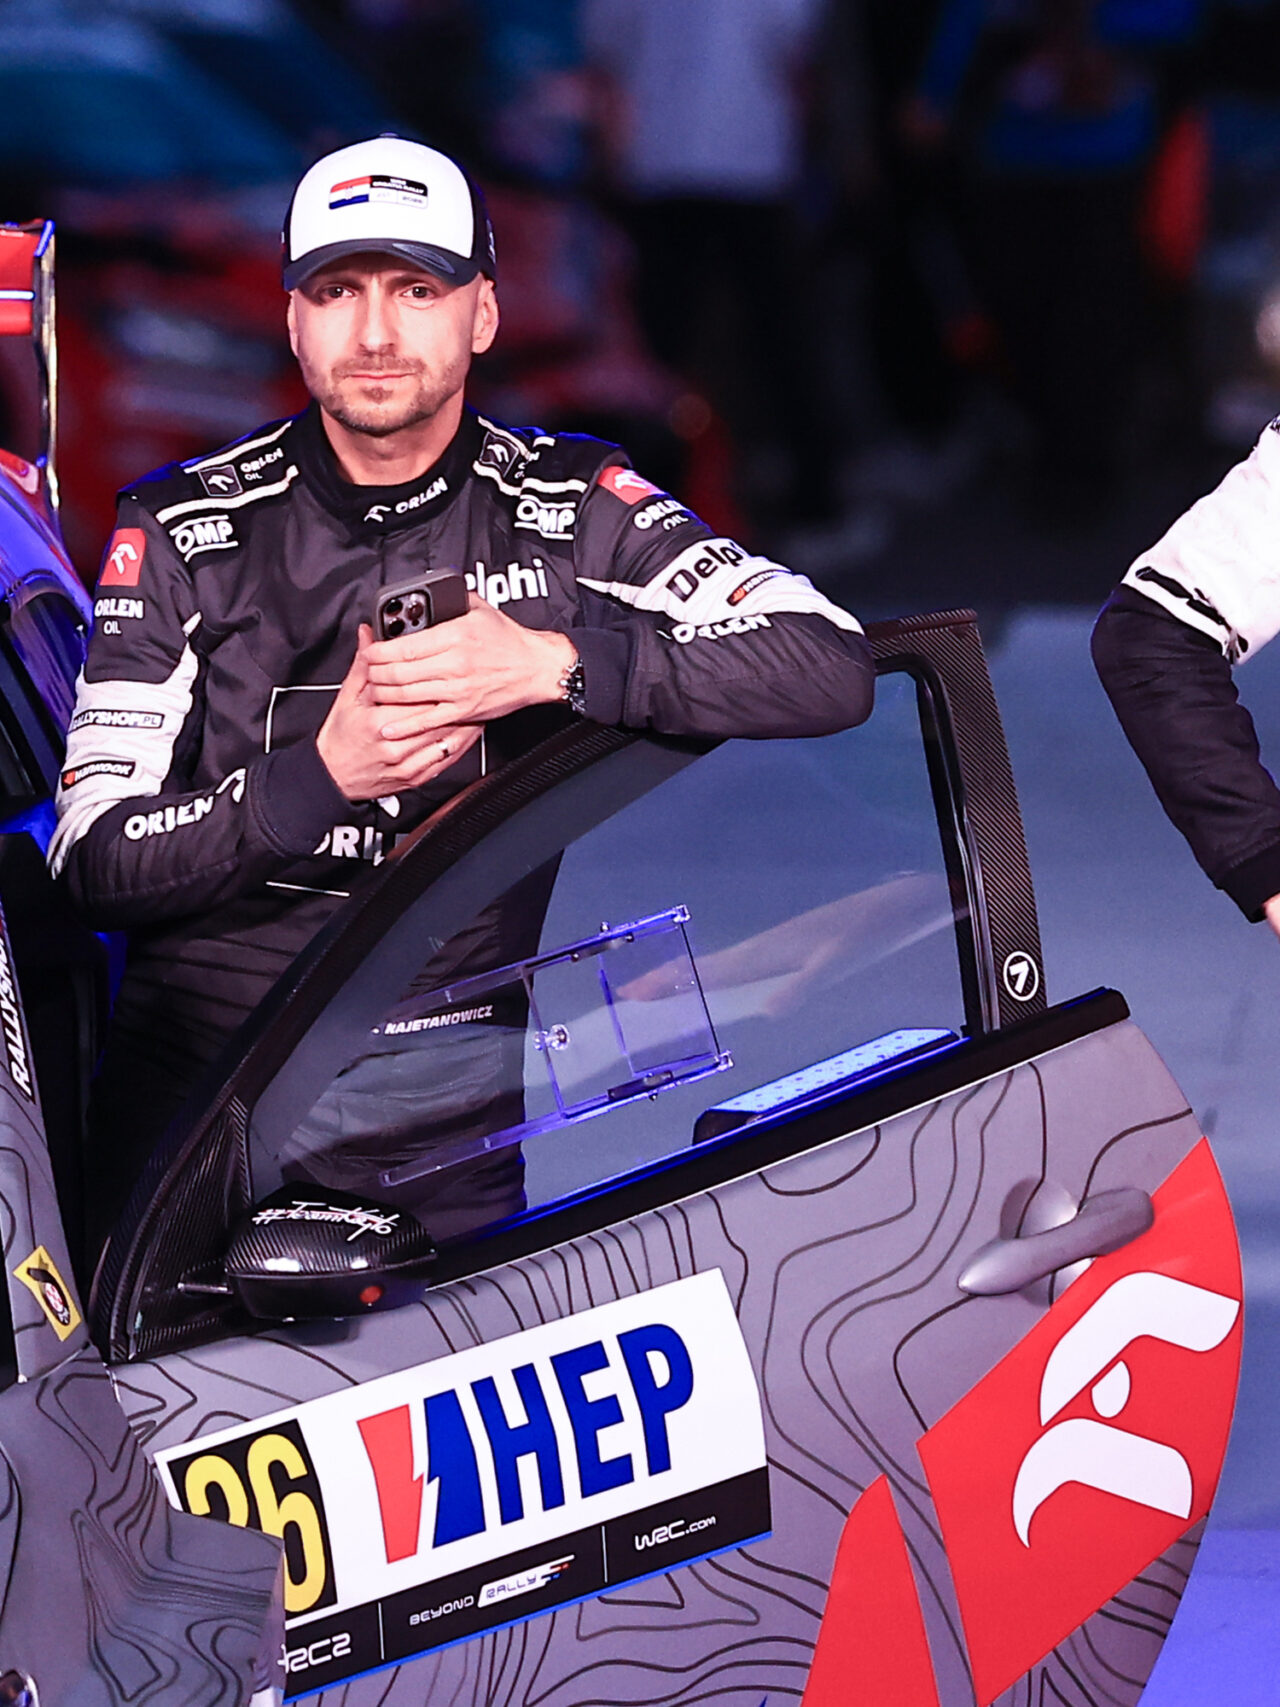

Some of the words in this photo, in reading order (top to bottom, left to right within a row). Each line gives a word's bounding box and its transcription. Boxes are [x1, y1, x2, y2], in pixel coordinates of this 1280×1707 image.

[240, 447, 284, 473] ORLEN
[244, 473, 263, 481] OIL
[395, 477, 449, 514] ORLEN
[516, 499, 576, 533] OMP
[175, 520, 233, 554] OMP
[94, 598, 144, 619] ORLEN
[103, 620, 121, 635] OIL
[469, 1323, 695, 1526] HEP
[409, 1594, 475, 1626] BEYOND
[282, 1632, 351, 1674] RC2
